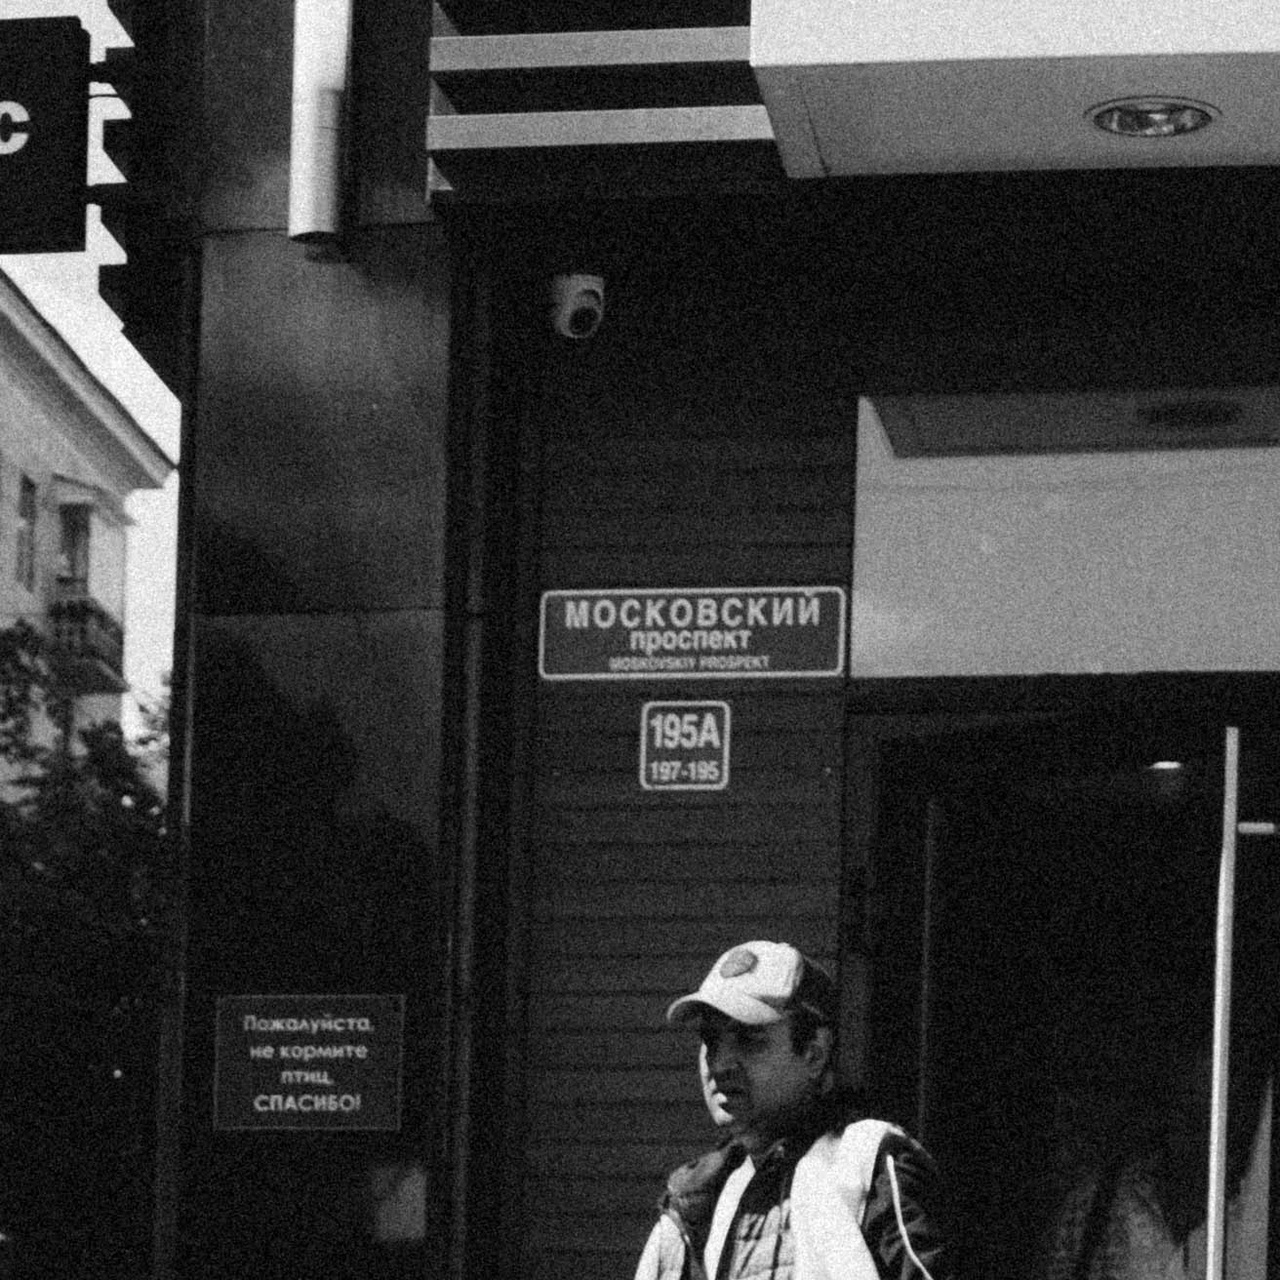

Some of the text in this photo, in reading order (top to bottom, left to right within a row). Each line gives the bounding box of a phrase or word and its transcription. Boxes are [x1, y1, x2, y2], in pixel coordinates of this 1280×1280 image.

[565, 592, 821, 629] МОСКОВСКИЙ
[629, 629, 752, 655] проспект
[650, 712, 720, 749] 195А
[650, 760, 720, 782] 197-195
[250, 1045, 368, 1061] не кормите
[253, 1093, 362, 1112] СПАСИБО!
